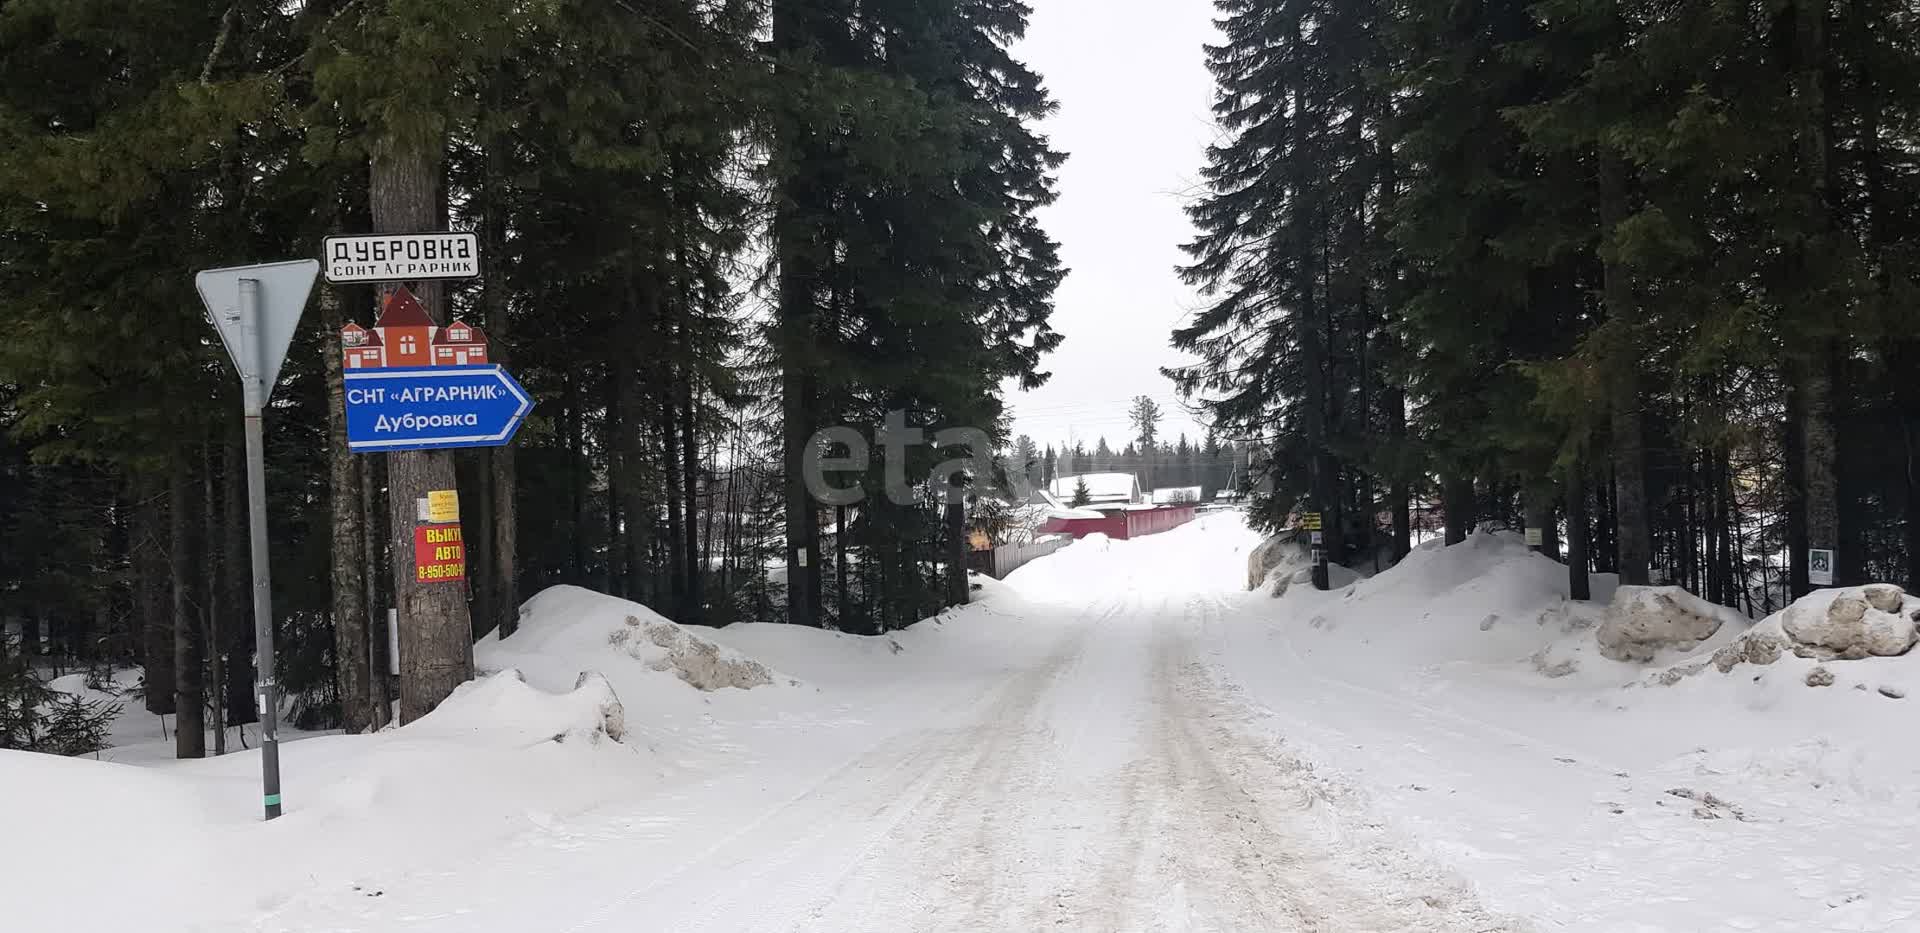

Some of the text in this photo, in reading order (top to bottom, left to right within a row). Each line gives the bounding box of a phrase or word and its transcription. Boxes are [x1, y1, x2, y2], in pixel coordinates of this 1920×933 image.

[333, 262, 472, 277] СОНТ АГРАРНИК
[347, 384, 507, 405] СНТ «АГРАРНИК»
[374, 413, 478, 433] Дубровка
[435, 546, 461, 561] АВТО
